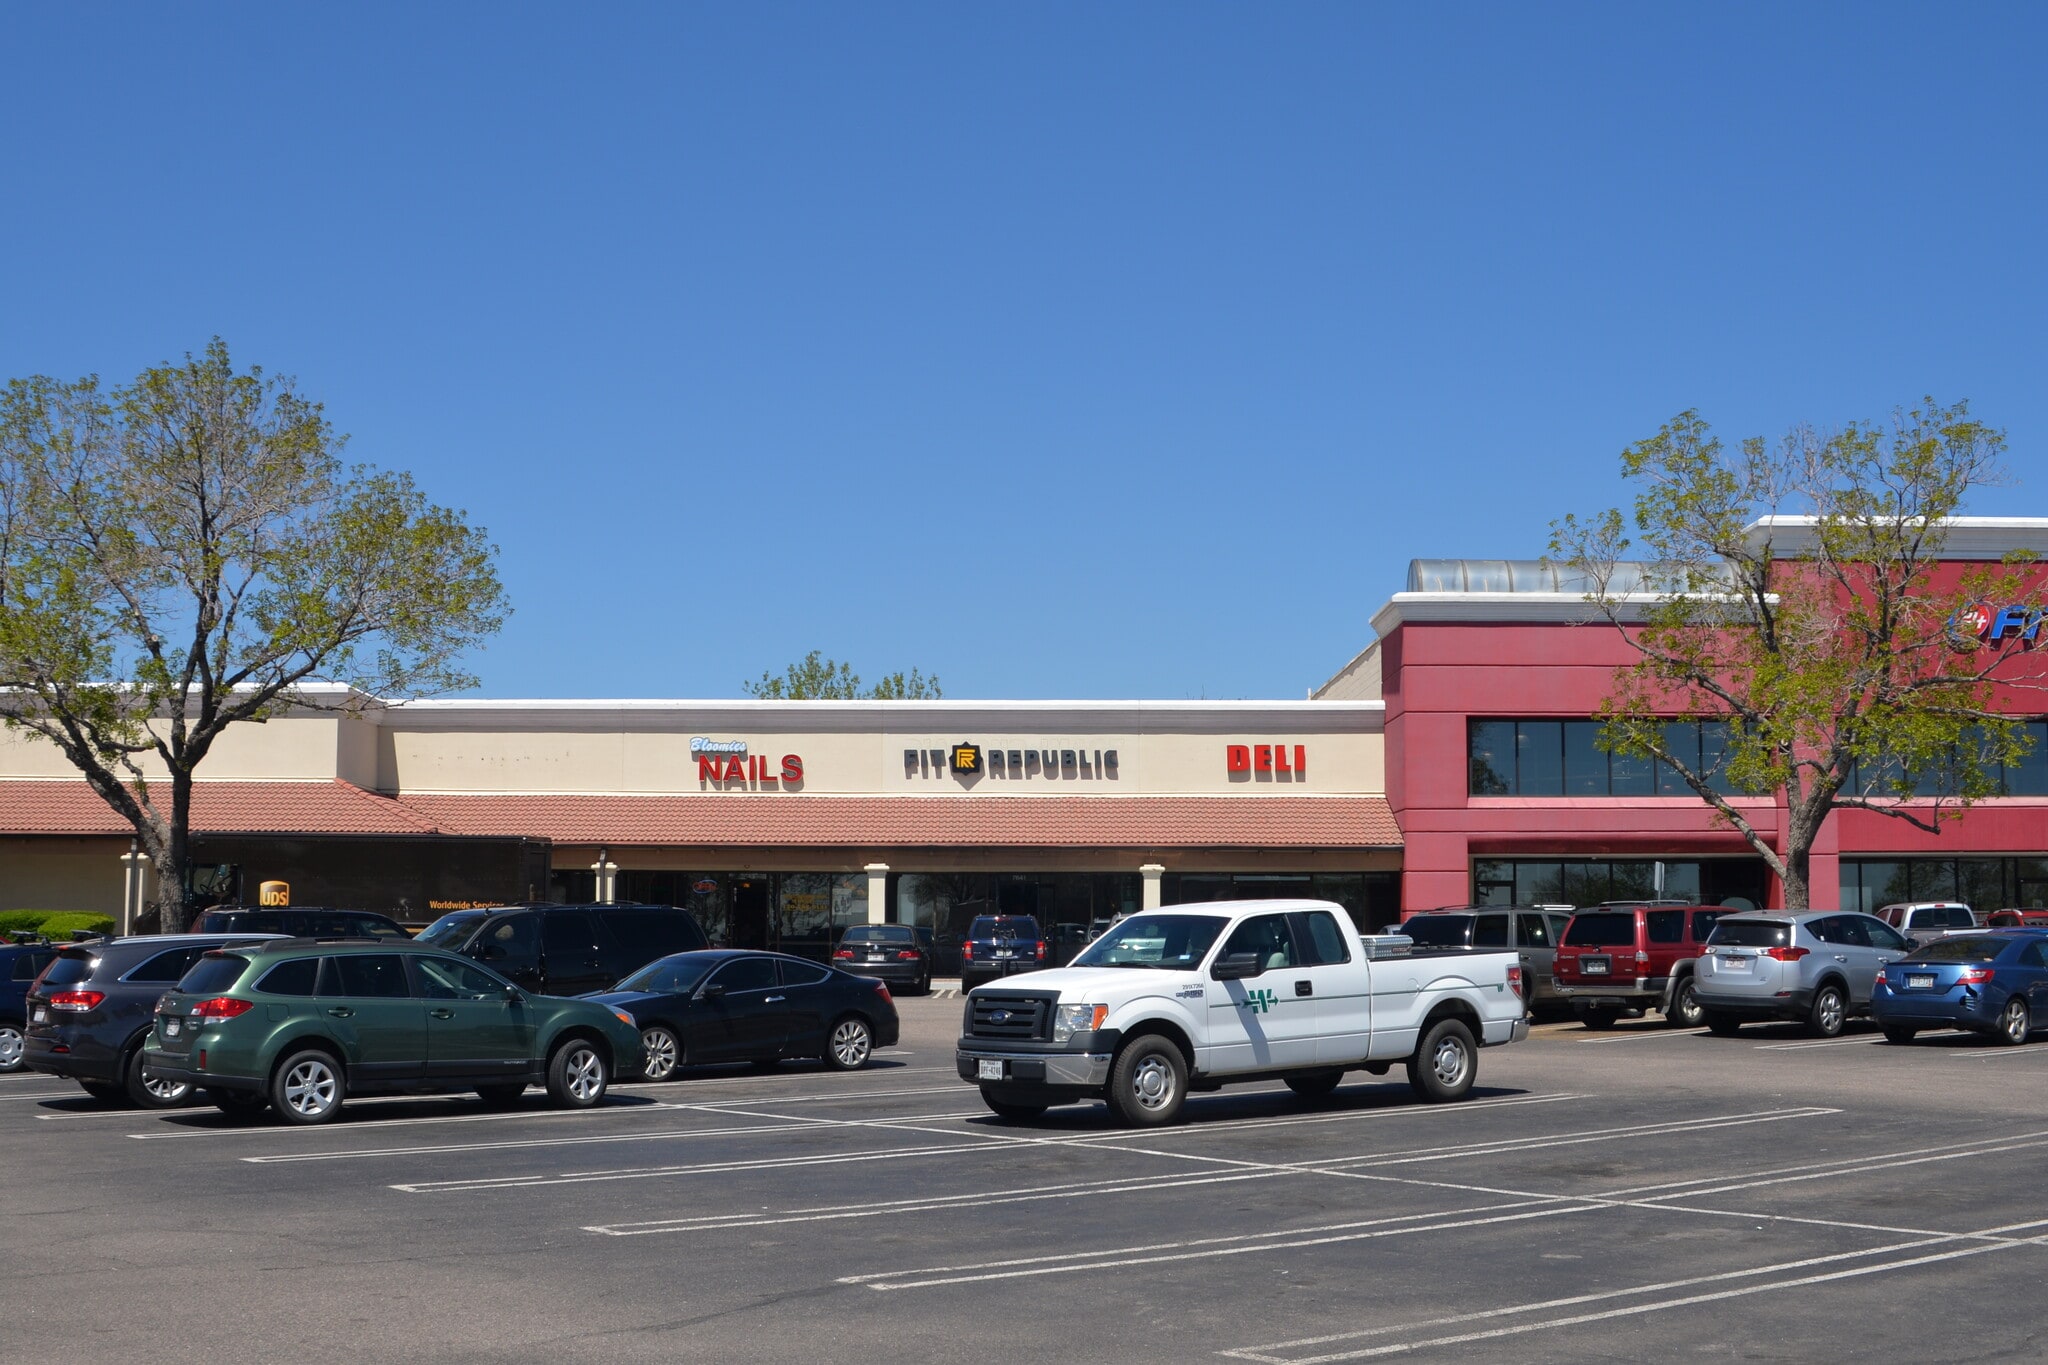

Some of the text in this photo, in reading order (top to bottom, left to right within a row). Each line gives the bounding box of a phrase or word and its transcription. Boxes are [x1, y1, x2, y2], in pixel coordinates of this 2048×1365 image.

[1990, 605, 2048, 639] FI
[690, 736, 747, 752] Bloomies
[698, 754, 804, 783] NAILS
[904, 750, 947, 768] FIT
[988, 750, 1119, 769] REPUBLIC
[1226, 745, 1306, 772] DELI
[429, 900, 471, 909] Worldwide
